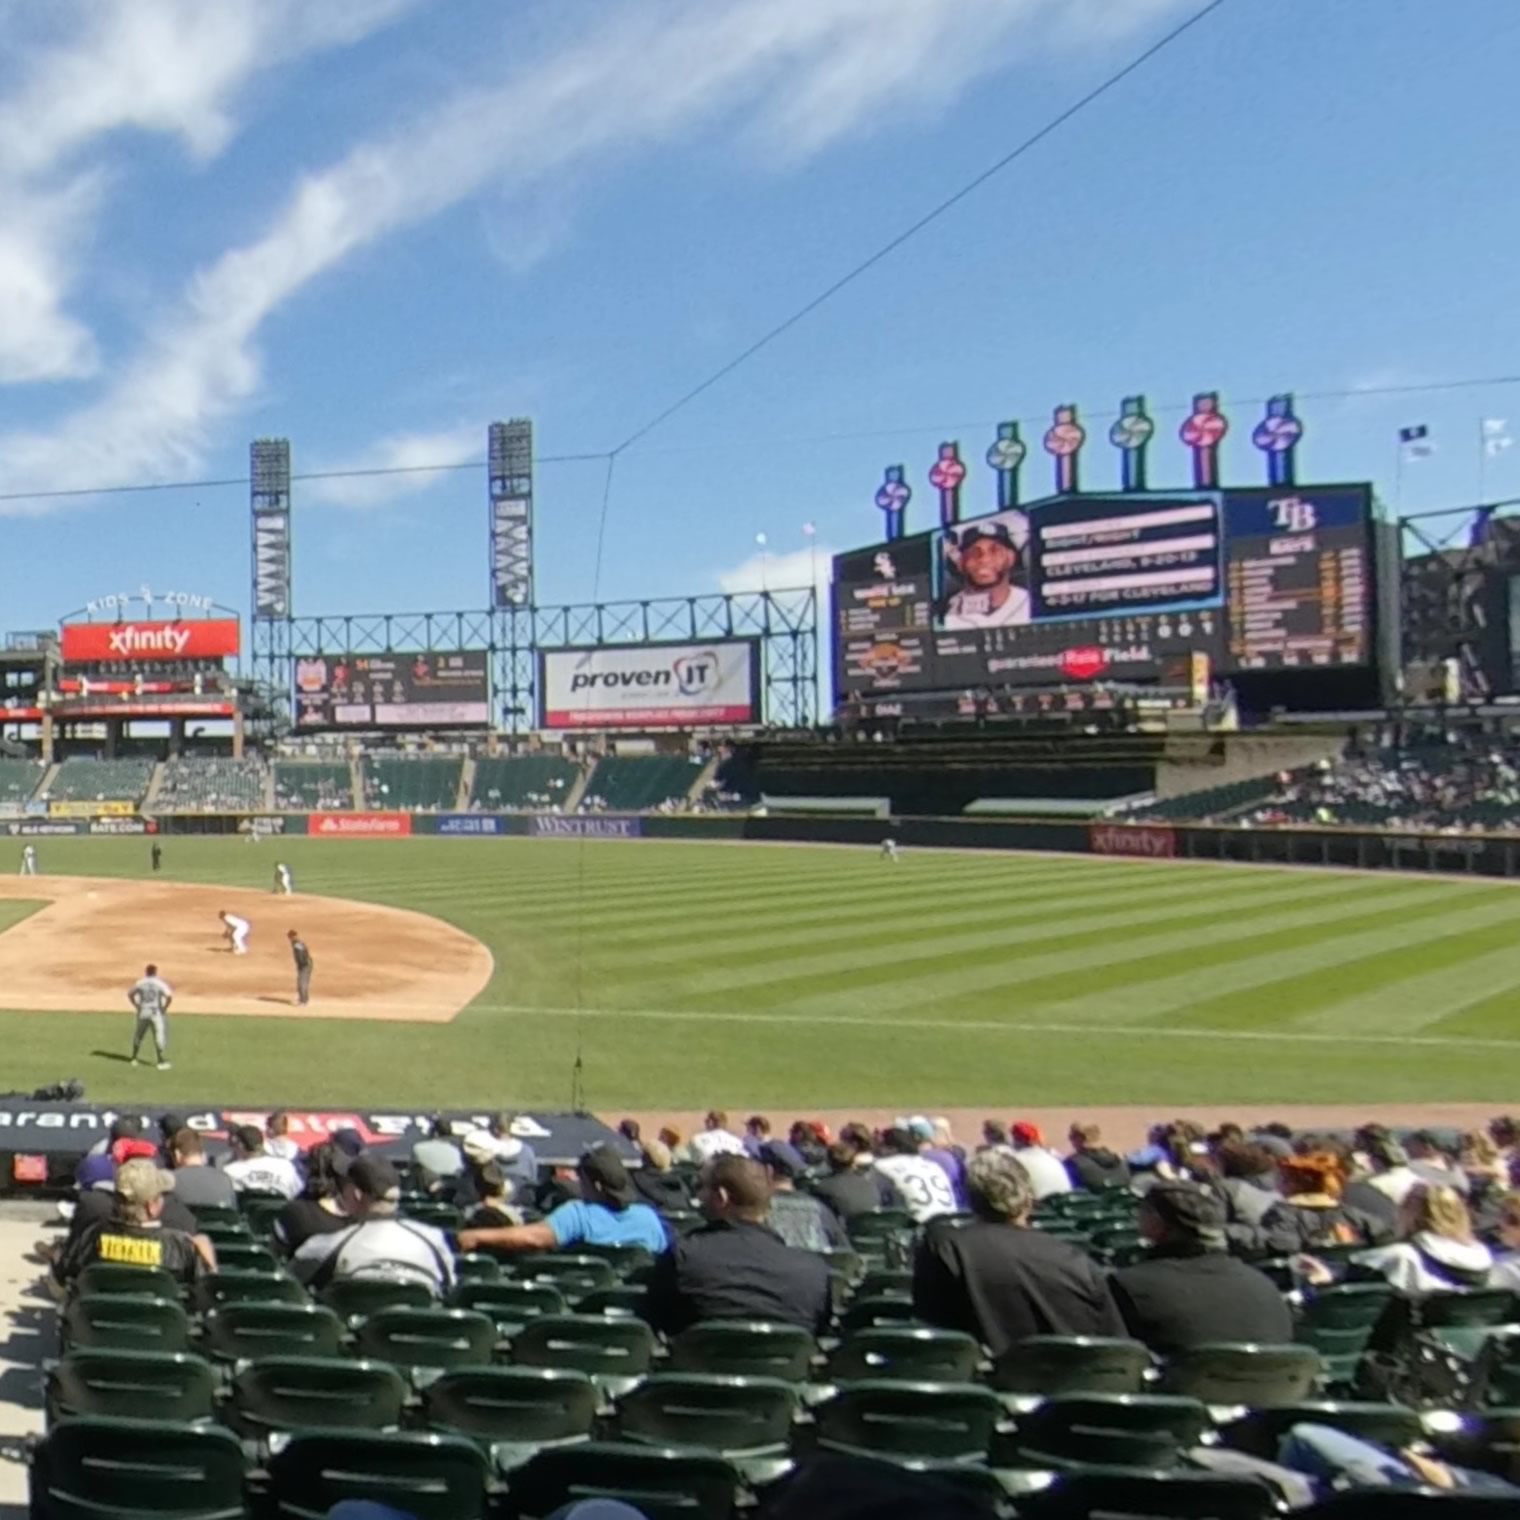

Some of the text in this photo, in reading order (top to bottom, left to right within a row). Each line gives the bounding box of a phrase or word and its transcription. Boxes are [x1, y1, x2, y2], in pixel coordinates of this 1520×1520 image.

[86, 590, 213, 612] KIDS ZONE
[1122, 581, 1213, 600] CLEVELAND
[108, 624, 192, 655] xfinity
[570, 664, 709, 692] proven IT
[1092, 829, 1160, 855] xfinity
[902, 1174, 953, 1208] 39
